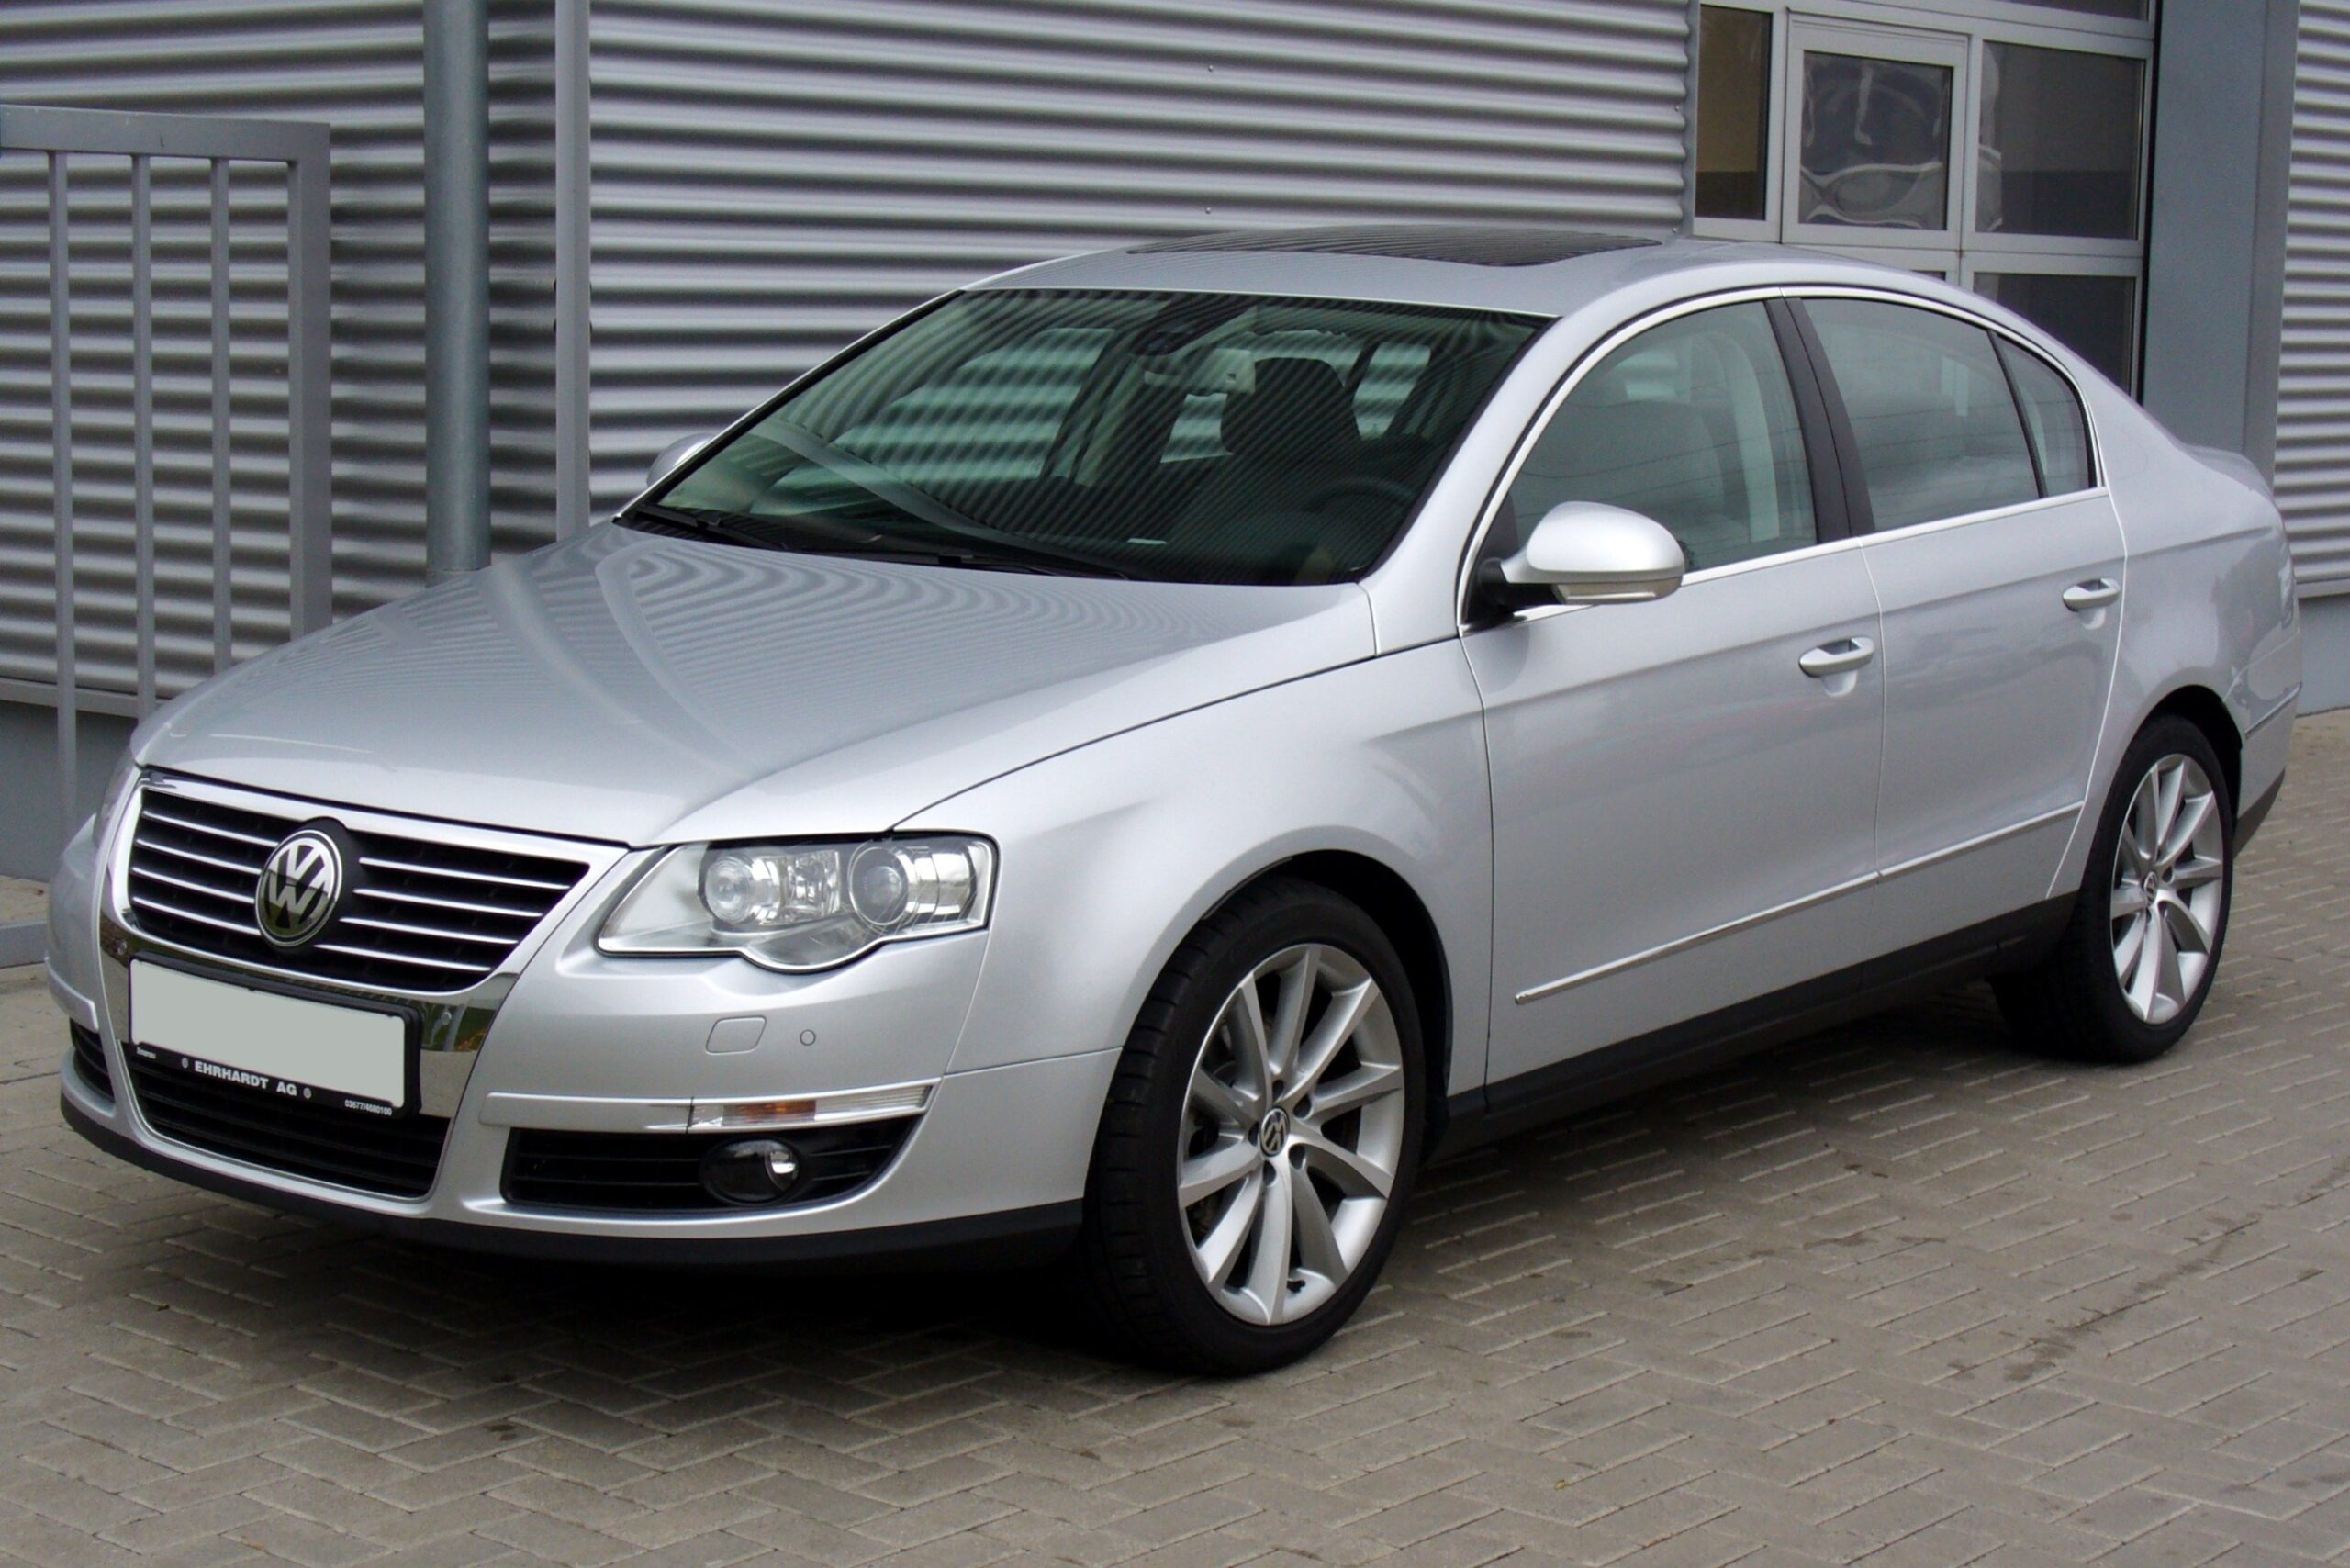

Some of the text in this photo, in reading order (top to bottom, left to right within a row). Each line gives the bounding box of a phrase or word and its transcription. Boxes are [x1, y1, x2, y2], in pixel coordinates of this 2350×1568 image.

[262, 836, 335, 937] VW
[194, 1059, 297, 1096] EHRHARDT AG
